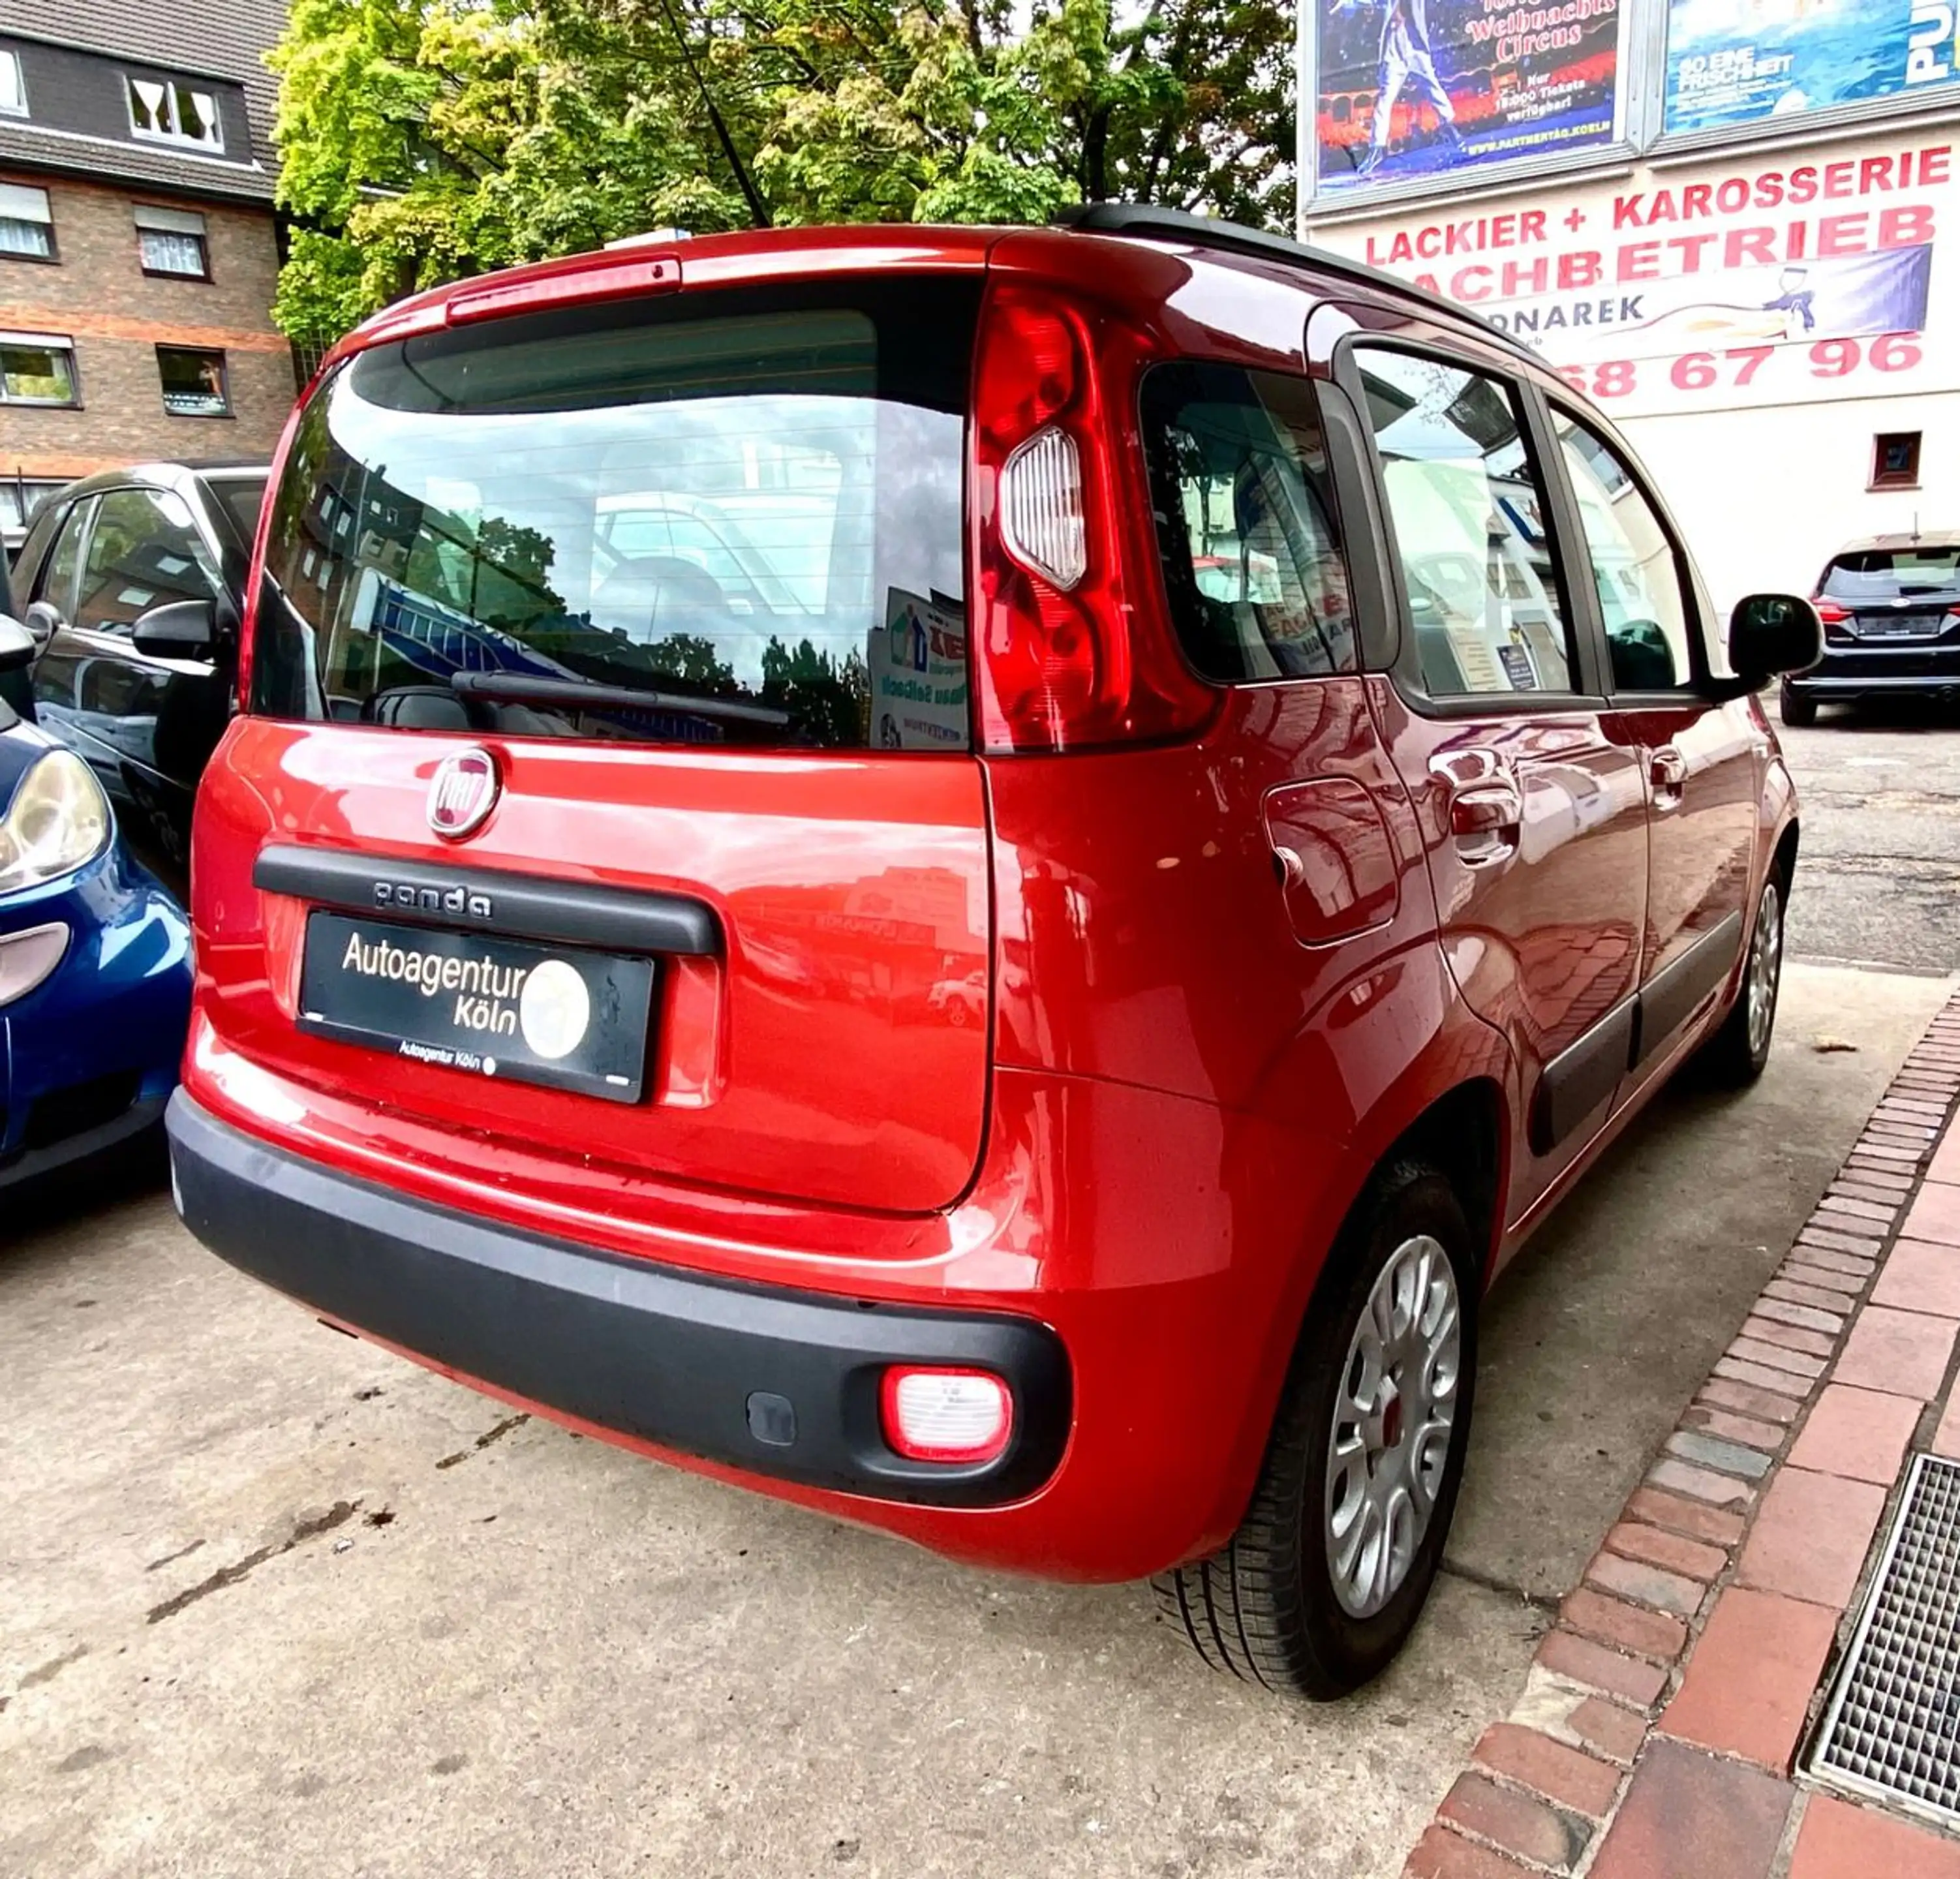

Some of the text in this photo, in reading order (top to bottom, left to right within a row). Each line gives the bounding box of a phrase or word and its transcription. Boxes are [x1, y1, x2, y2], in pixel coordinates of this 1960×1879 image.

[1496, 24, 1582, 63] Circus
[1709, 46, 1755, 70] EINE
[1527, 73, 1551, 87] Nur
[1539, 79, 1585, 98] Tickets
[1366, 210, 1548, 266] LACKIER
[1613, 145, 1952, 230] KAROSSERIE
[1414, 205, 1937, 301] ACHBETRIEB
[1488, 294, 1644, 334] DNAREK
[1670, 344, 1775, 390] 67
[1809, 331, 1923, 379] 96
[373, 881, 493, 919] panda
[341, 931, 527, 998] Autoagentur
[454, 994, 517, 1036] Köln
[399, 1040, 481, 1069] Autoagentur Köln
